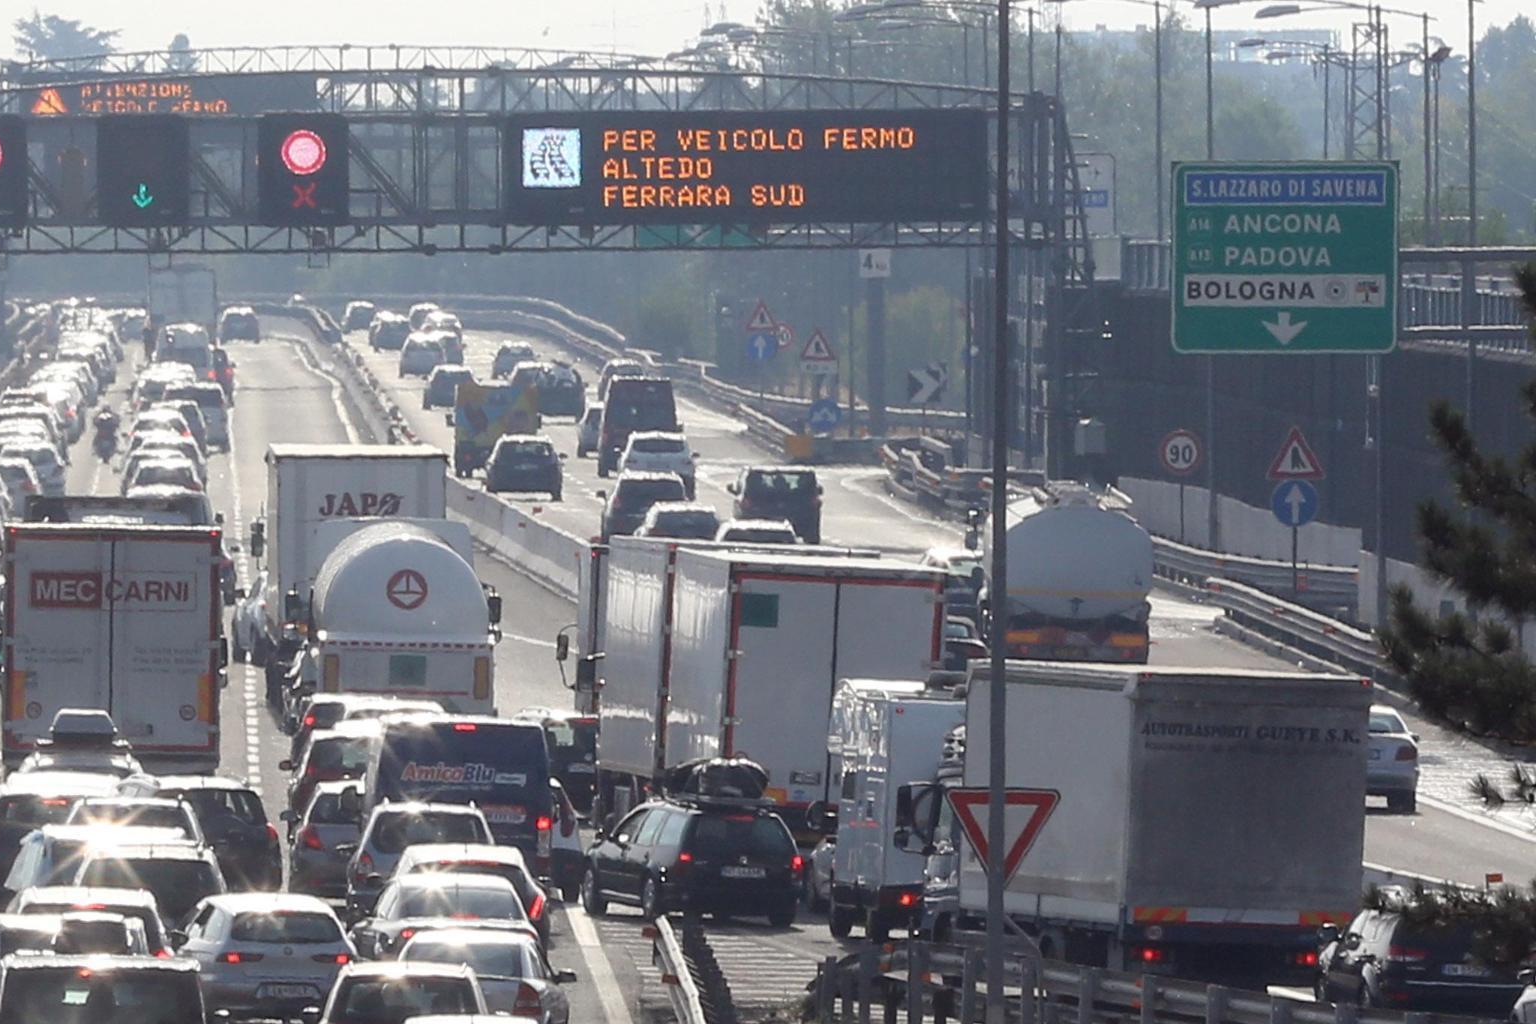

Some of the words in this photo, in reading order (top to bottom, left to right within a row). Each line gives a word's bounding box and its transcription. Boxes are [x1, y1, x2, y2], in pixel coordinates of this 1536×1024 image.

[604, 130, 657, 152] PER
[677, 129, 804, 152] VEICOLO
[824, 127, 916, 150] FERMO
[604, 157, 713, 180] ALTEDO
[604, 185, 731, 208] FERRARA
[751, 184, 805, 207] SUD
[1288, 179, 1305, 197] DI
[1312, 179, 1379, 197] SAVENA
[1223, 213, 1342, 235] ANCONA
[863, 253, 873, 270] 4
[1224, 246, 1332, 268] PADOVA
[1186, 280, 1316, 301] BOLOGNA
[1170, 444, 1193, 465] 90
[35, 579, 96, 602] MEC
[104, 580, 190, 603] CARNI
[401, 761, 495, 783] AmicoBlu
